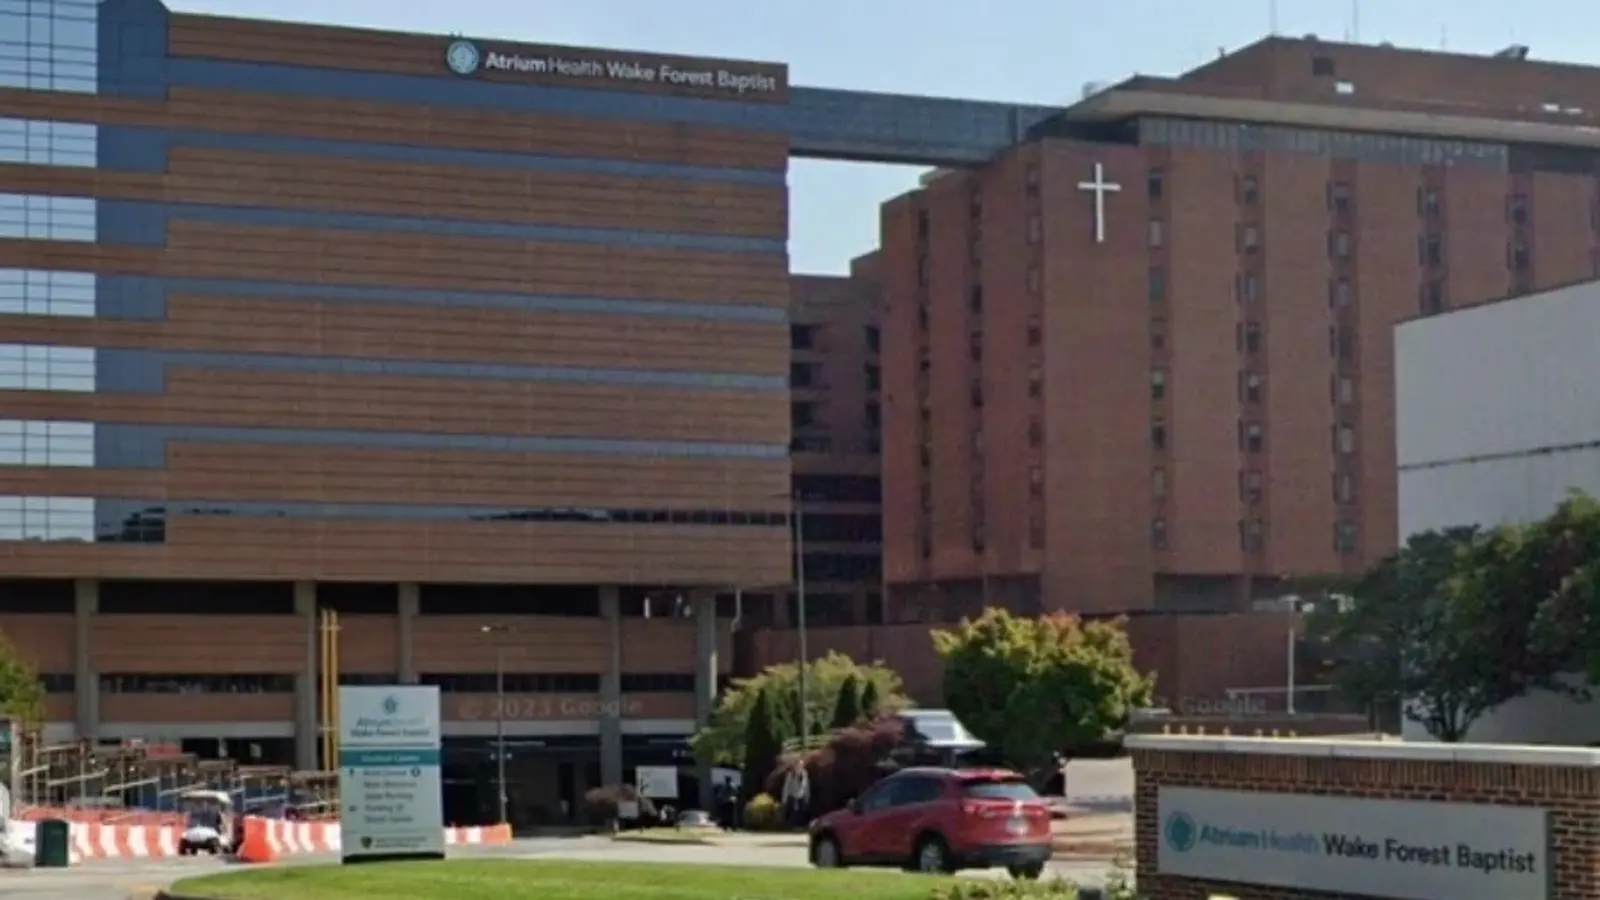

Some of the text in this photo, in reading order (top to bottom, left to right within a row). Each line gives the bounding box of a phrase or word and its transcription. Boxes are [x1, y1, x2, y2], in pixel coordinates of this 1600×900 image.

[485, 51, 546, 73] Atrium
[605, 60, 655, 82] Wake
[660, 64, 713, 86] Forest
[718, 69, 776, 93] Baptist
[1200, 823, 1259, 849] Atrium
[1322, 831, 1380, 859] Wake
[1384, 836, 1451, 866] Forest
[1456, 843, 1536, 875] Baptist
